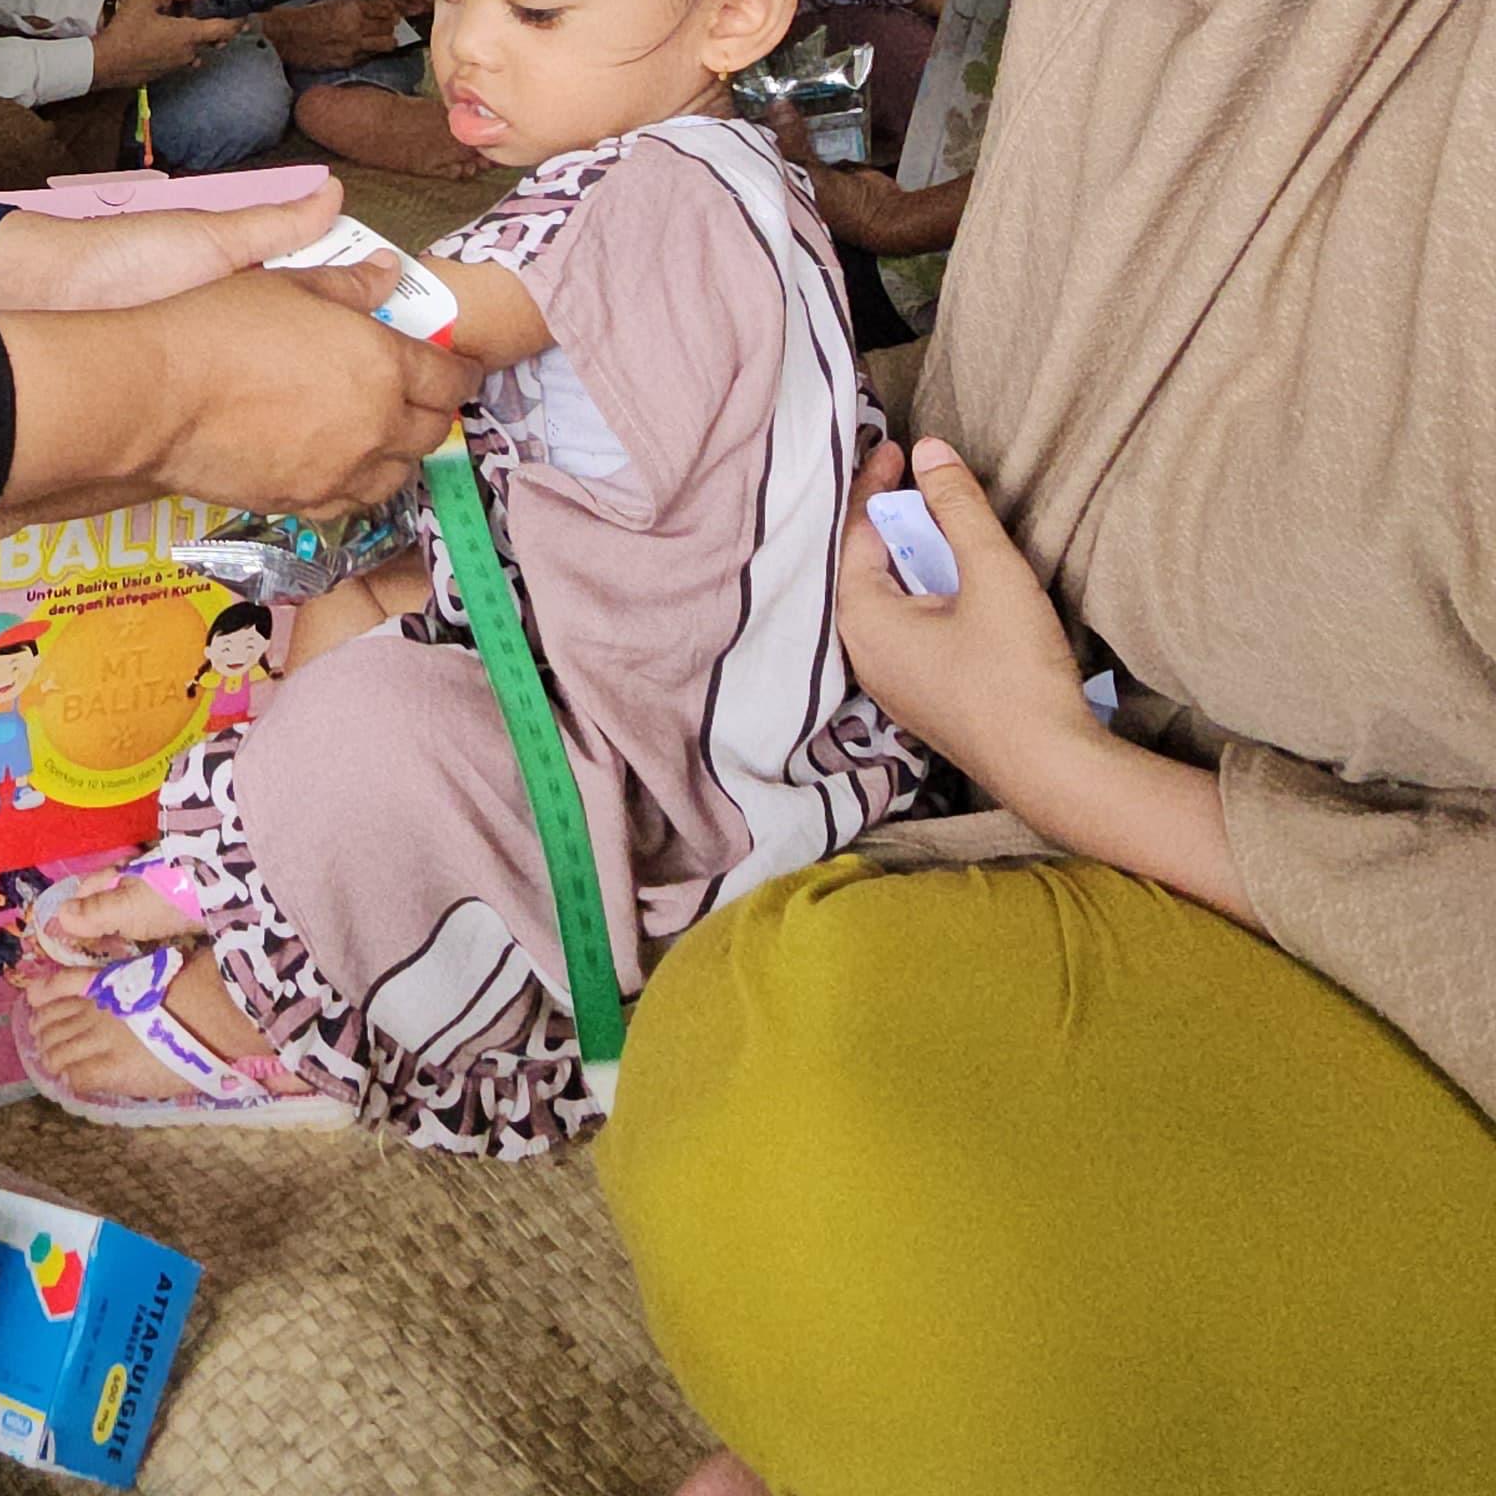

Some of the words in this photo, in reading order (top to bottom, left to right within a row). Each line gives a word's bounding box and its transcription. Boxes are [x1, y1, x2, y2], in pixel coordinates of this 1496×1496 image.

[26, 586, 72, 602] Untuk
[75, 578, 118, 595] Balita
[121, 572, 152, 587] Usia
[48, 599, 104, 616] dengan
[105, 587, 168, 608] Kategori
[170, 582, 212, 599] Kurus
[101, 648, 150, 683] MT
[62, 679, 183, 724] BALITA
[106, 1271, 173, 1464] ATTAPULGITE
[107, 1373, 123, 1404] 600
[96, 1408, 112, 1433] mg
